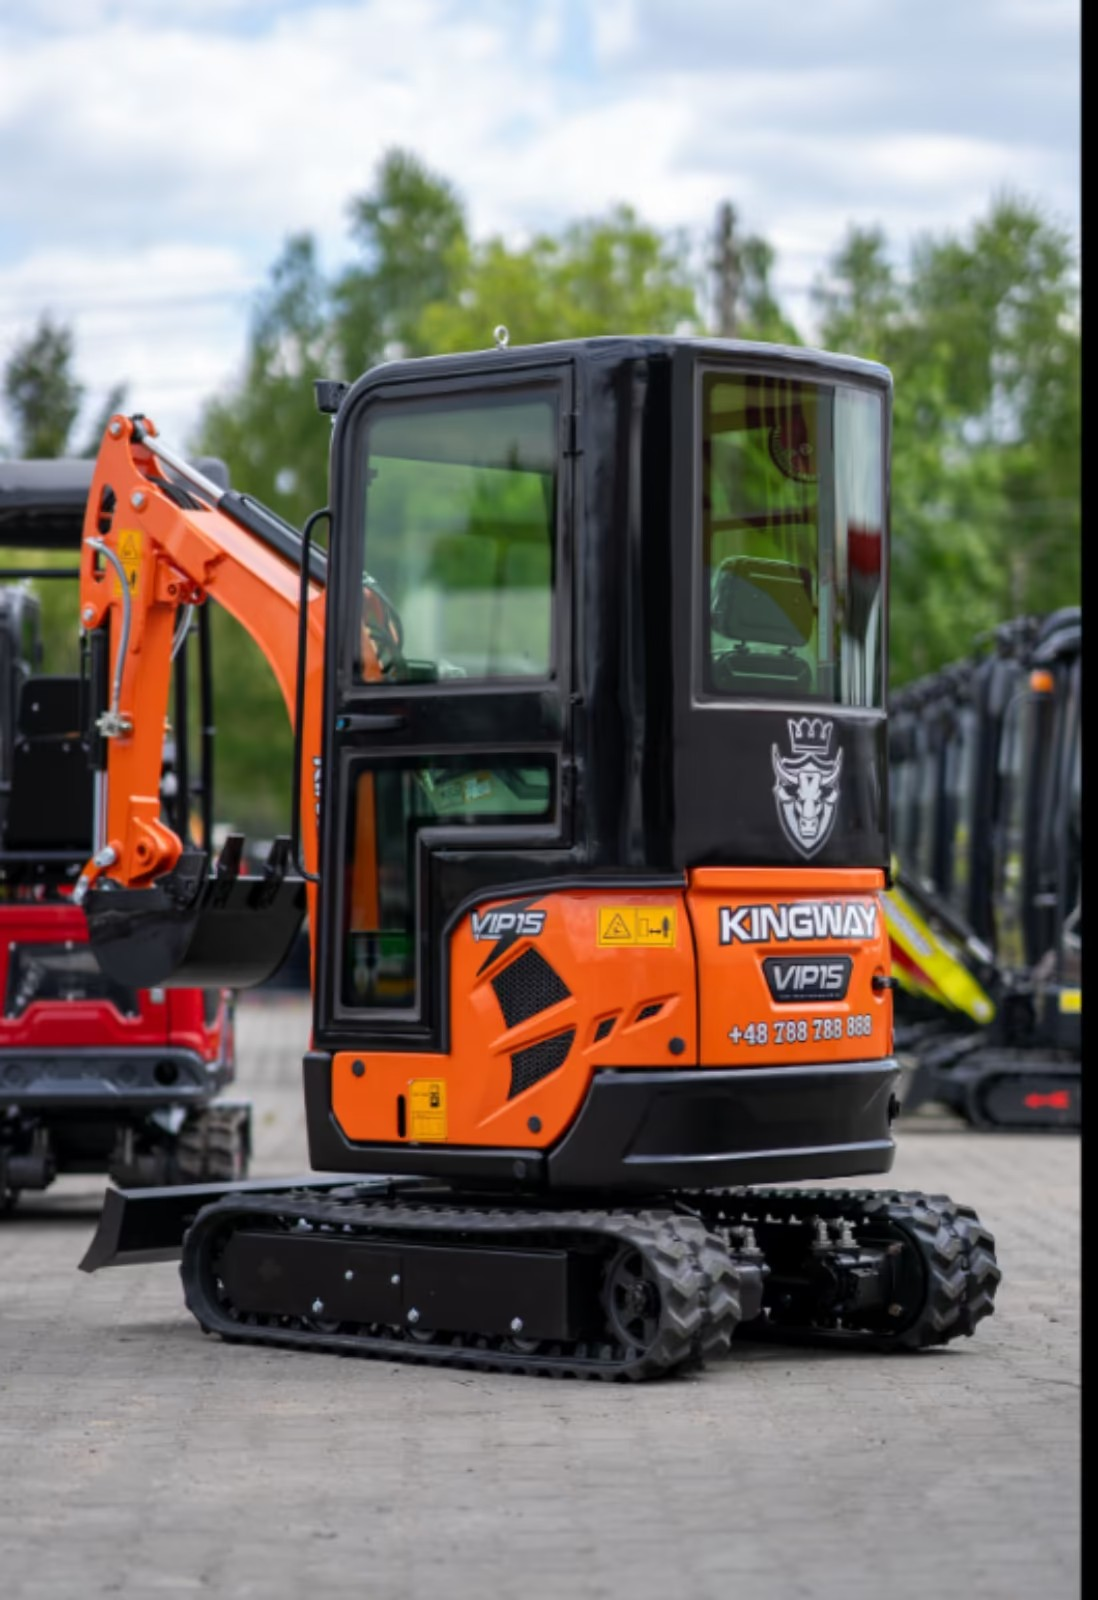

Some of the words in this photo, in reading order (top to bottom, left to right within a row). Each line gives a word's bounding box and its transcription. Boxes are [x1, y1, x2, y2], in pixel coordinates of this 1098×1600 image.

[471, 910, 546, 937] VIP15
[719, 904, 877, 945] KINGWAY
[772, 964, 845, 991] VIP15
[728, 1022, 768, 1045] +48
[774, 1020, 808, 1044] 788
[812, 1017, 842, 1041] 788
[846, 1013, 873, 1037] 888
